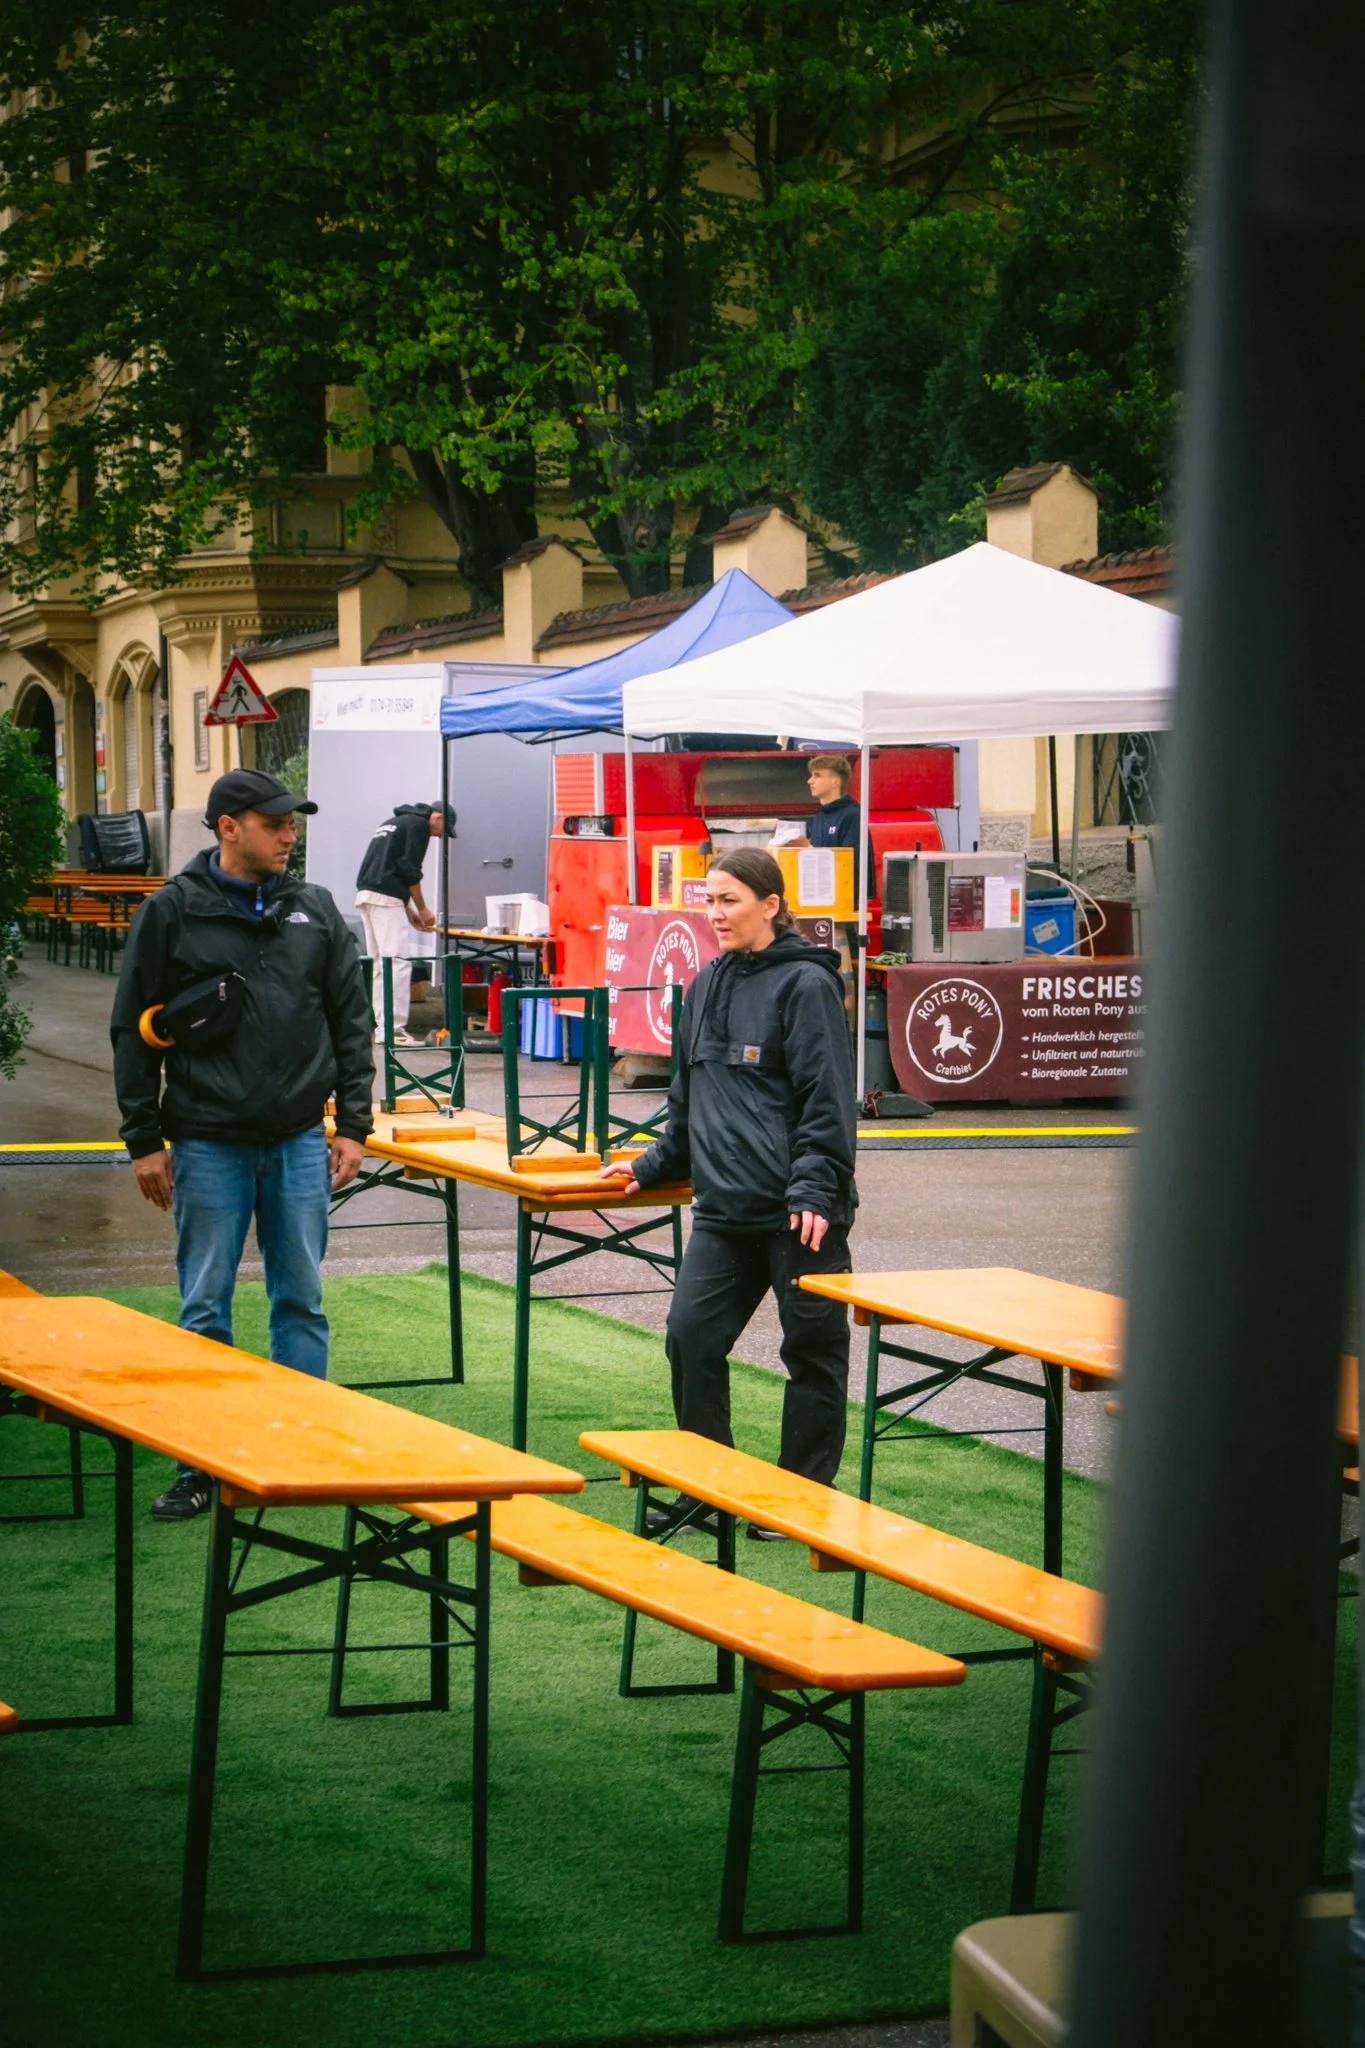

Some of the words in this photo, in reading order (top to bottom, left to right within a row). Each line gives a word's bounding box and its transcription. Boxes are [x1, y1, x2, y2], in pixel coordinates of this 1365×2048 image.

[607, 916, 629, 941] Bier
[655, 931, 679, 968] ROTES
[679, 934, 696, 970] PONY
[1022, 975, 1143, 1000] FRISCHES
[916, 987, 958, 1021] ROTES
[960, 988, 994, 1019] PONY
[1022, 1007, 1049, 1017] vom
[1052, 1003, 1090, 1016] Roten
[1094, 1002, 1124, 1018] Pony
[1127, 1004, 1148, 1015] aus
[1031, 1030, 1095, 1043] Handwerklich
[1031, 1049, 1077, 1062] Unfiltriert
[1080, 1047, 1098, 1059] und
[935, 1062, 972, 1075] Craftbier
[1031, 1066, 1088, 1080] Bioregionale
[1090, 1065, 1128, 1077] Zutaten
